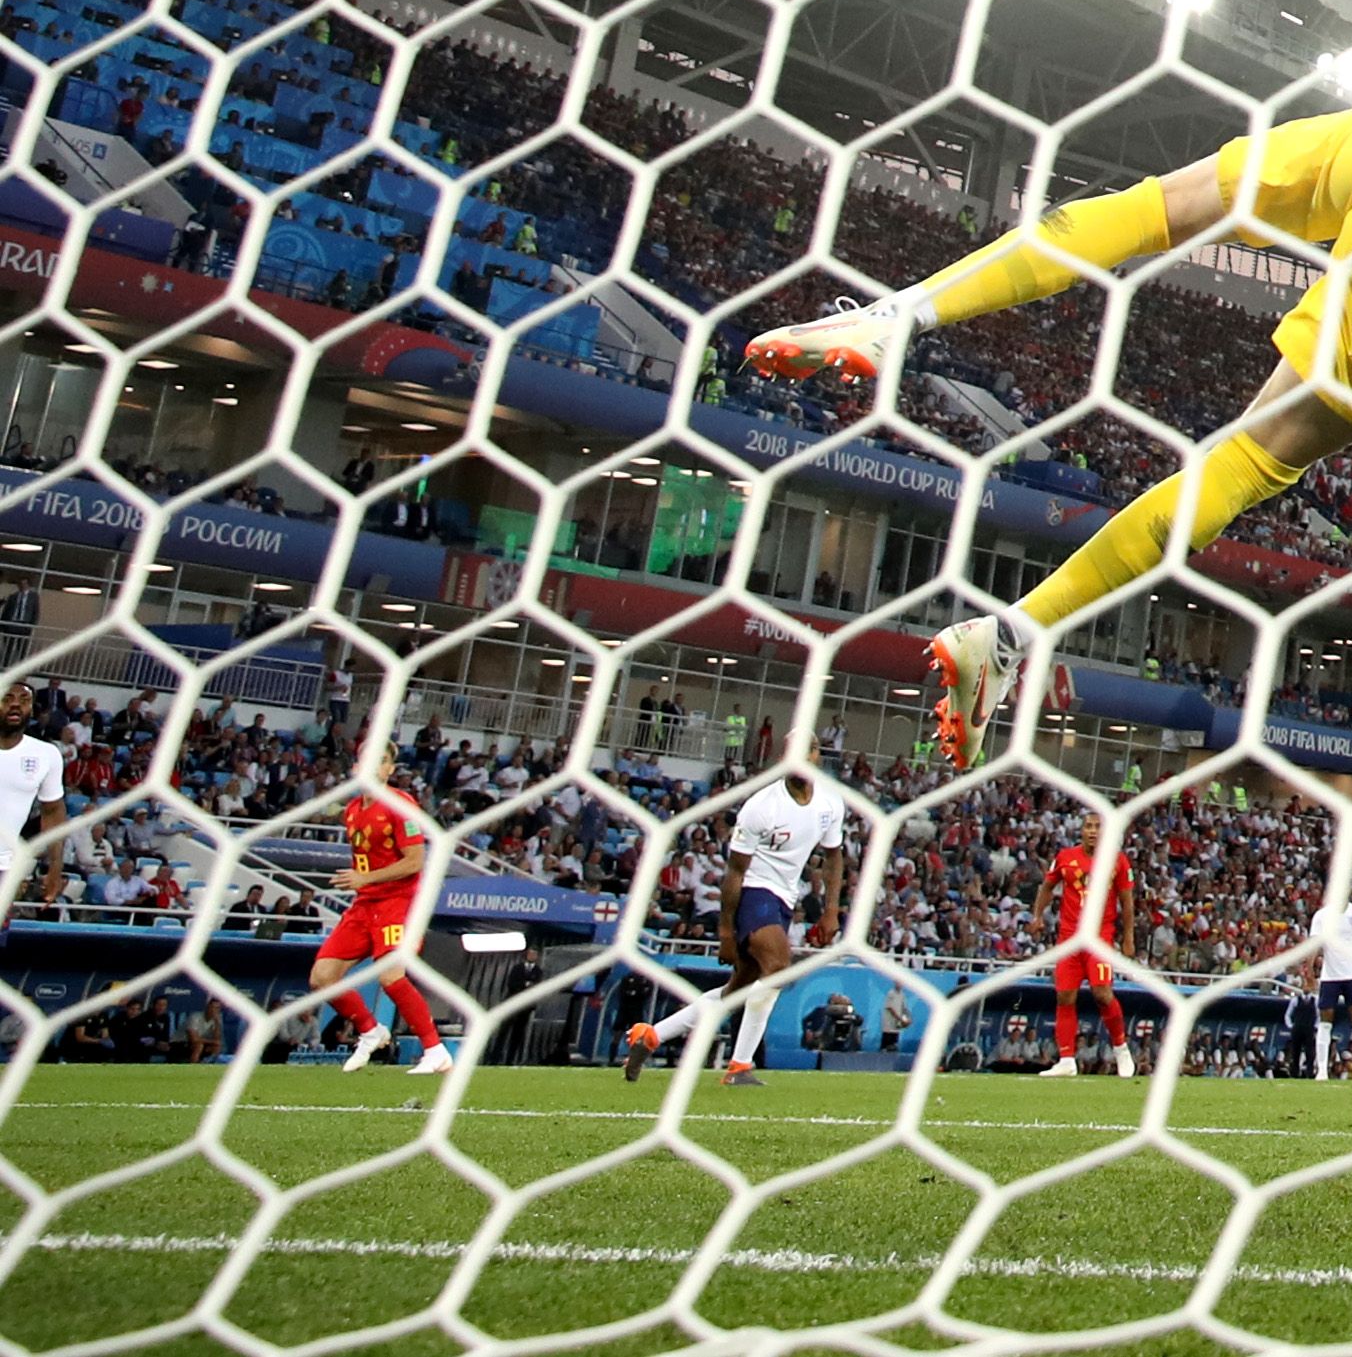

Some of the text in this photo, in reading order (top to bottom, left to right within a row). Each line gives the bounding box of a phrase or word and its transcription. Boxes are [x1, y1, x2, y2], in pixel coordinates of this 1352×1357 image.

[745, 429, 789, 458] 2018
[792, 440, 830, 470] FA
[834, 450, 896, 485] WORLD
[899, 467, 934, 493] CUP
[26, 489, 83, 521] FIFA
[87, 499, 147, 531] 2018
[180, 516, 284, 555] РОССИИ
[1261, 725, 1288, 745] 2018
[1288, 729, 1316, 751] FIFA
[447, 892, 549, 914] KALININGRAD
[381, 924, 405, 947] 18
